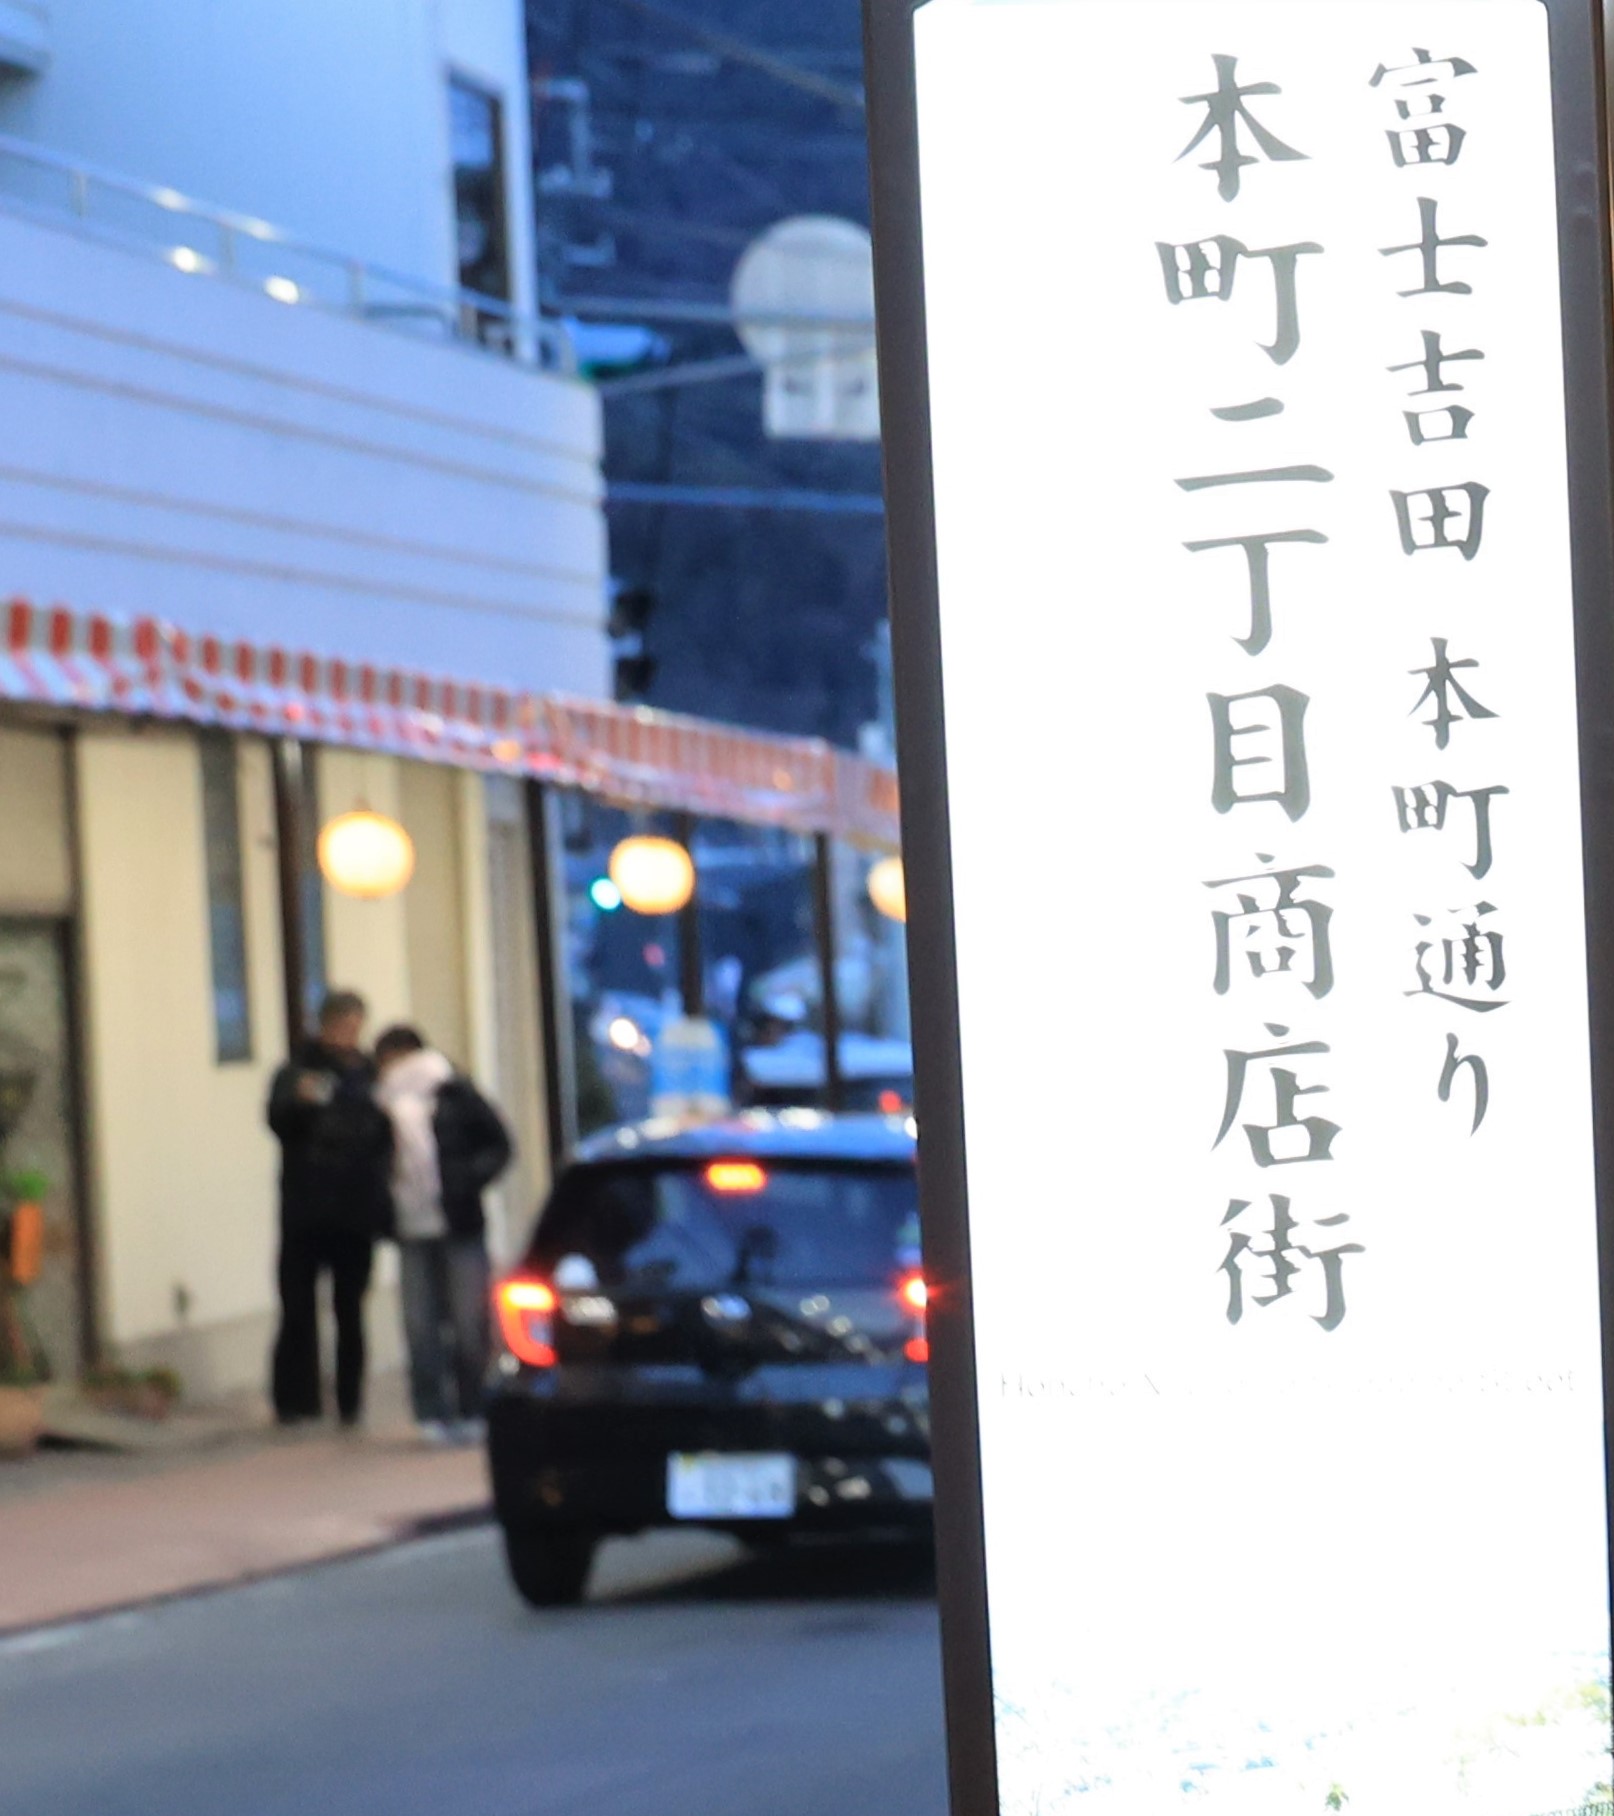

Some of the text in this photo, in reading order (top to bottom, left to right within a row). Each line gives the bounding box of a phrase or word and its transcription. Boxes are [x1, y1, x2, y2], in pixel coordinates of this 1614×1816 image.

[1155, 54, 1365, 1332] 本町二丁目商店街
[1369, 47, 1511, 1135] 富士吉田 本町通り
